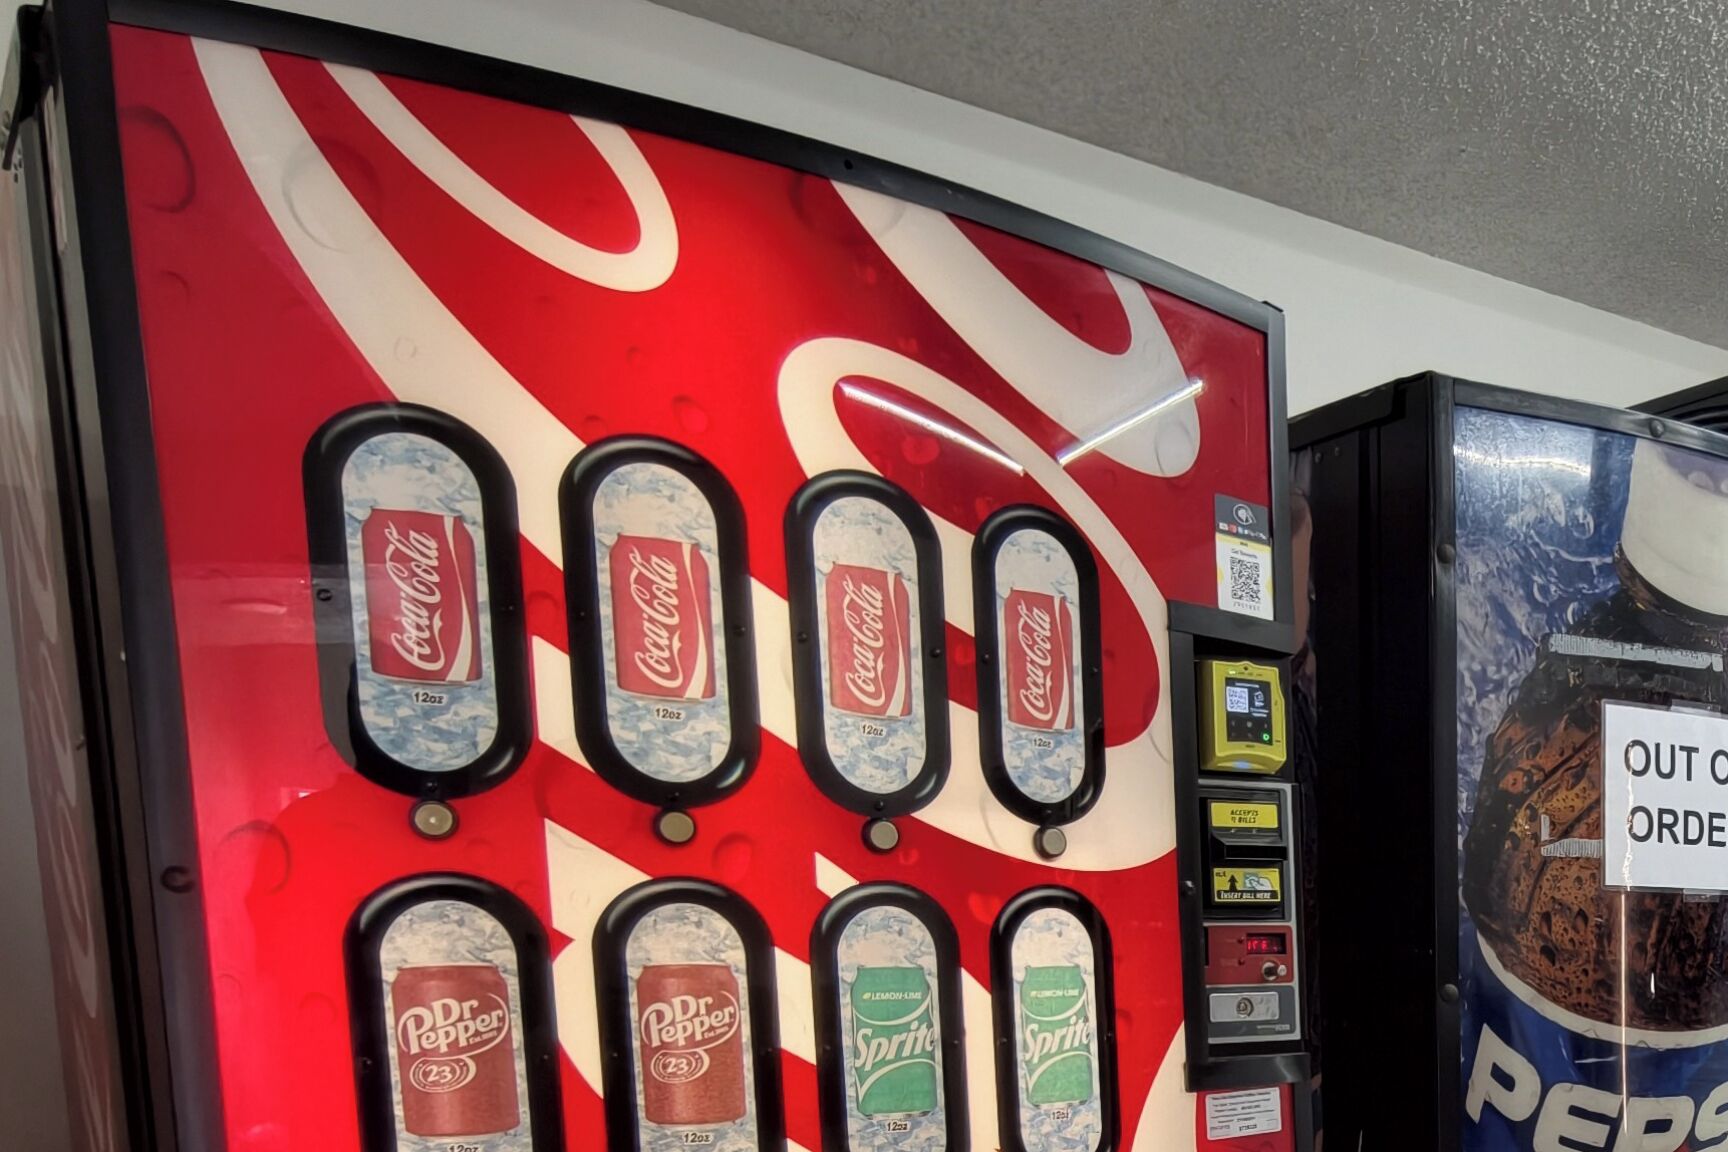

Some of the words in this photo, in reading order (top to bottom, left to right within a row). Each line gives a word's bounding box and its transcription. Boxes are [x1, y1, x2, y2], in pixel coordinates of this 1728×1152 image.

[413, 692, 444, 705] 12oz
[654, 707, 682, 720] 12oz
[1624, 739, 1699, 782] OUT
[431, 998, 479, 1028] Dr
[671, 994, 713, 1022] Dr
[398, 1007, 503, 1055] Pepper
[641, 1002, 734, 1048] Pepper
[1024, 1016, 1090, 1063] Sprite
[855, 1020, 935, 1071] Sprite
[425, 1065, 453, 1083] 23
[665, 1057, 690, 1074] 23
[684, 1133, 710, 1144] 12oz
